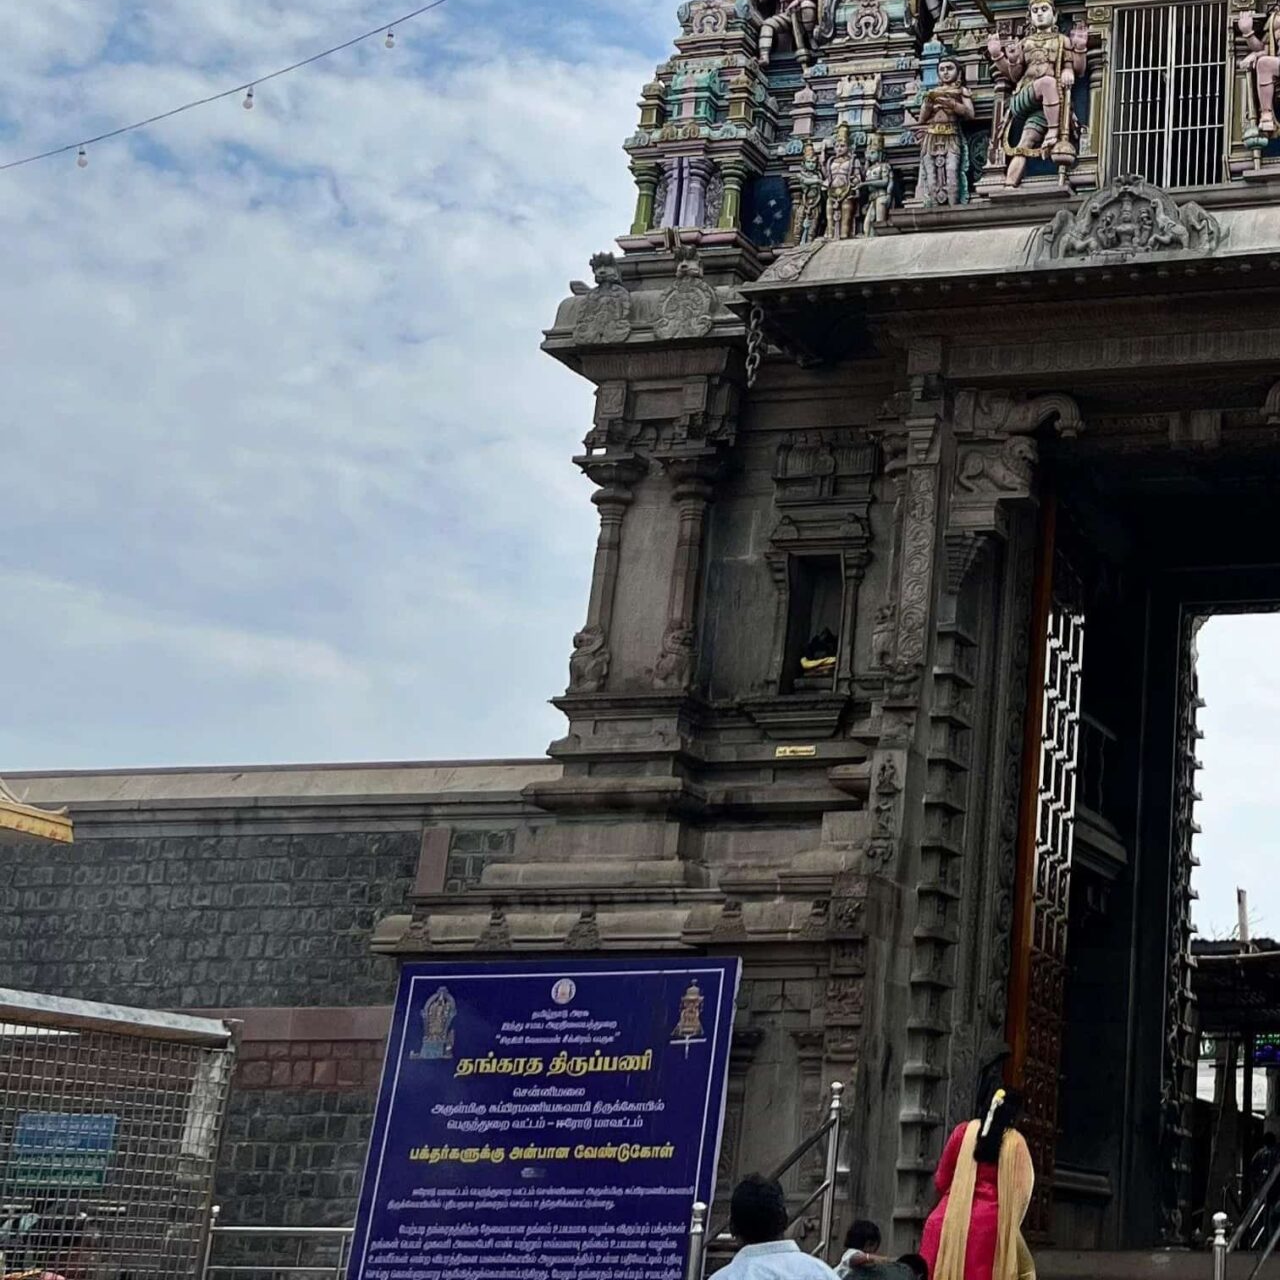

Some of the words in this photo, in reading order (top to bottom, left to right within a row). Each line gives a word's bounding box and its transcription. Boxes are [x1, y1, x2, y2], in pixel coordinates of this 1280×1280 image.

[454, 1052, 543, 1077] தங்கரத
[547, 1049, 652, 1076] திருப்பணி
[513, 1085, 585, 1097] சென்னிமலை
[431, 1102, 486, 1116] அருள்மிகு
[489, 1101, 591, 1114] சுப்பிரமணியசுவாமி
[593, 1099, 664, 1114] திருக்கோயில்
[447, 1118, 510, 1132] பெருந்துறை
[512, 1117, 545, 1128] வட்டம்
[556, 1119, 592, 1129] ஈரோடு
[594, 1115, 643, 1127] மாவட்டம்
[410, 1145, 504, 1163] பக்தர்களுக்கு
[509, 1143, 570, 1160] அன்பான
[574, 1142, 674, 1161] வேண்டுகோள்
